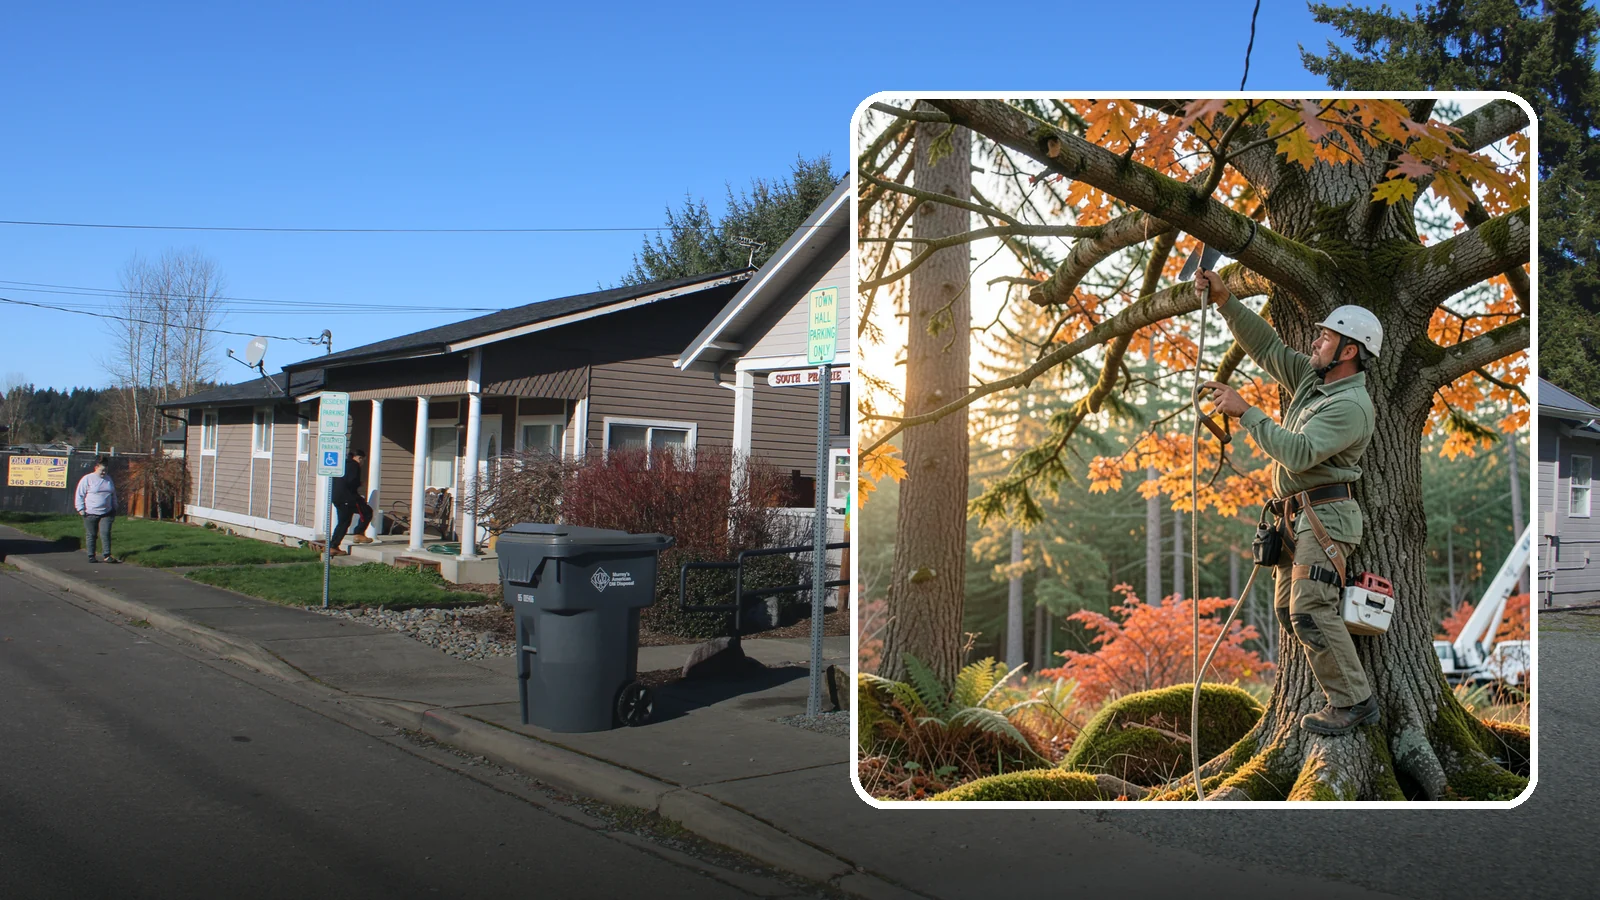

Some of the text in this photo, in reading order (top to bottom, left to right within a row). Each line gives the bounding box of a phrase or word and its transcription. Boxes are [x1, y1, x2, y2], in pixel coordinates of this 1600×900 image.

[815, 294, 833, 308] TOWN
[814, 312, 831, 324] HALL
[810, 326, 836, 340] PARKING
[813, 343, 831, 357] ONLY
[775, 373, 801, 384] SOUTH
